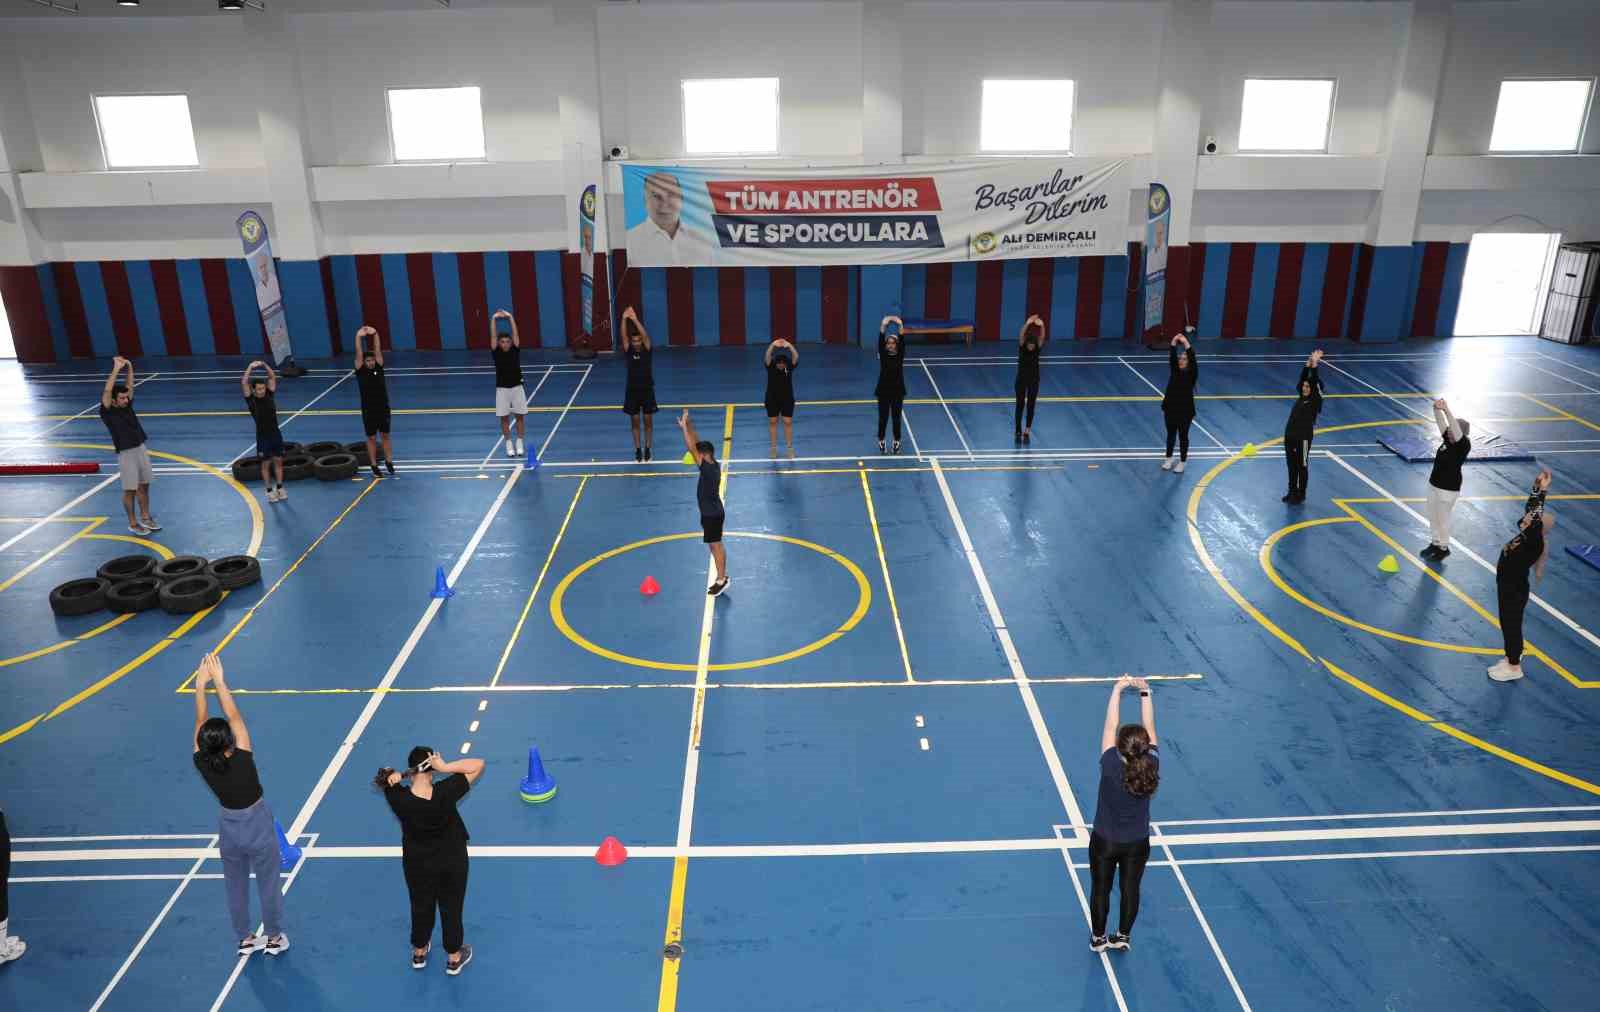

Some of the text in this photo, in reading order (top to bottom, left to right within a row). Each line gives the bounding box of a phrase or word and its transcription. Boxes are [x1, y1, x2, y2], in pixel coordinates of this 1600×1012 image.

[725, 182, 918, 210] TÜM ANTRENÖR
[975, 168, 1083, 211] Başarılar
[1025, 193, 1108, 225] Dilerim
[727, 222, 928, 243] VE SPORCULARA
